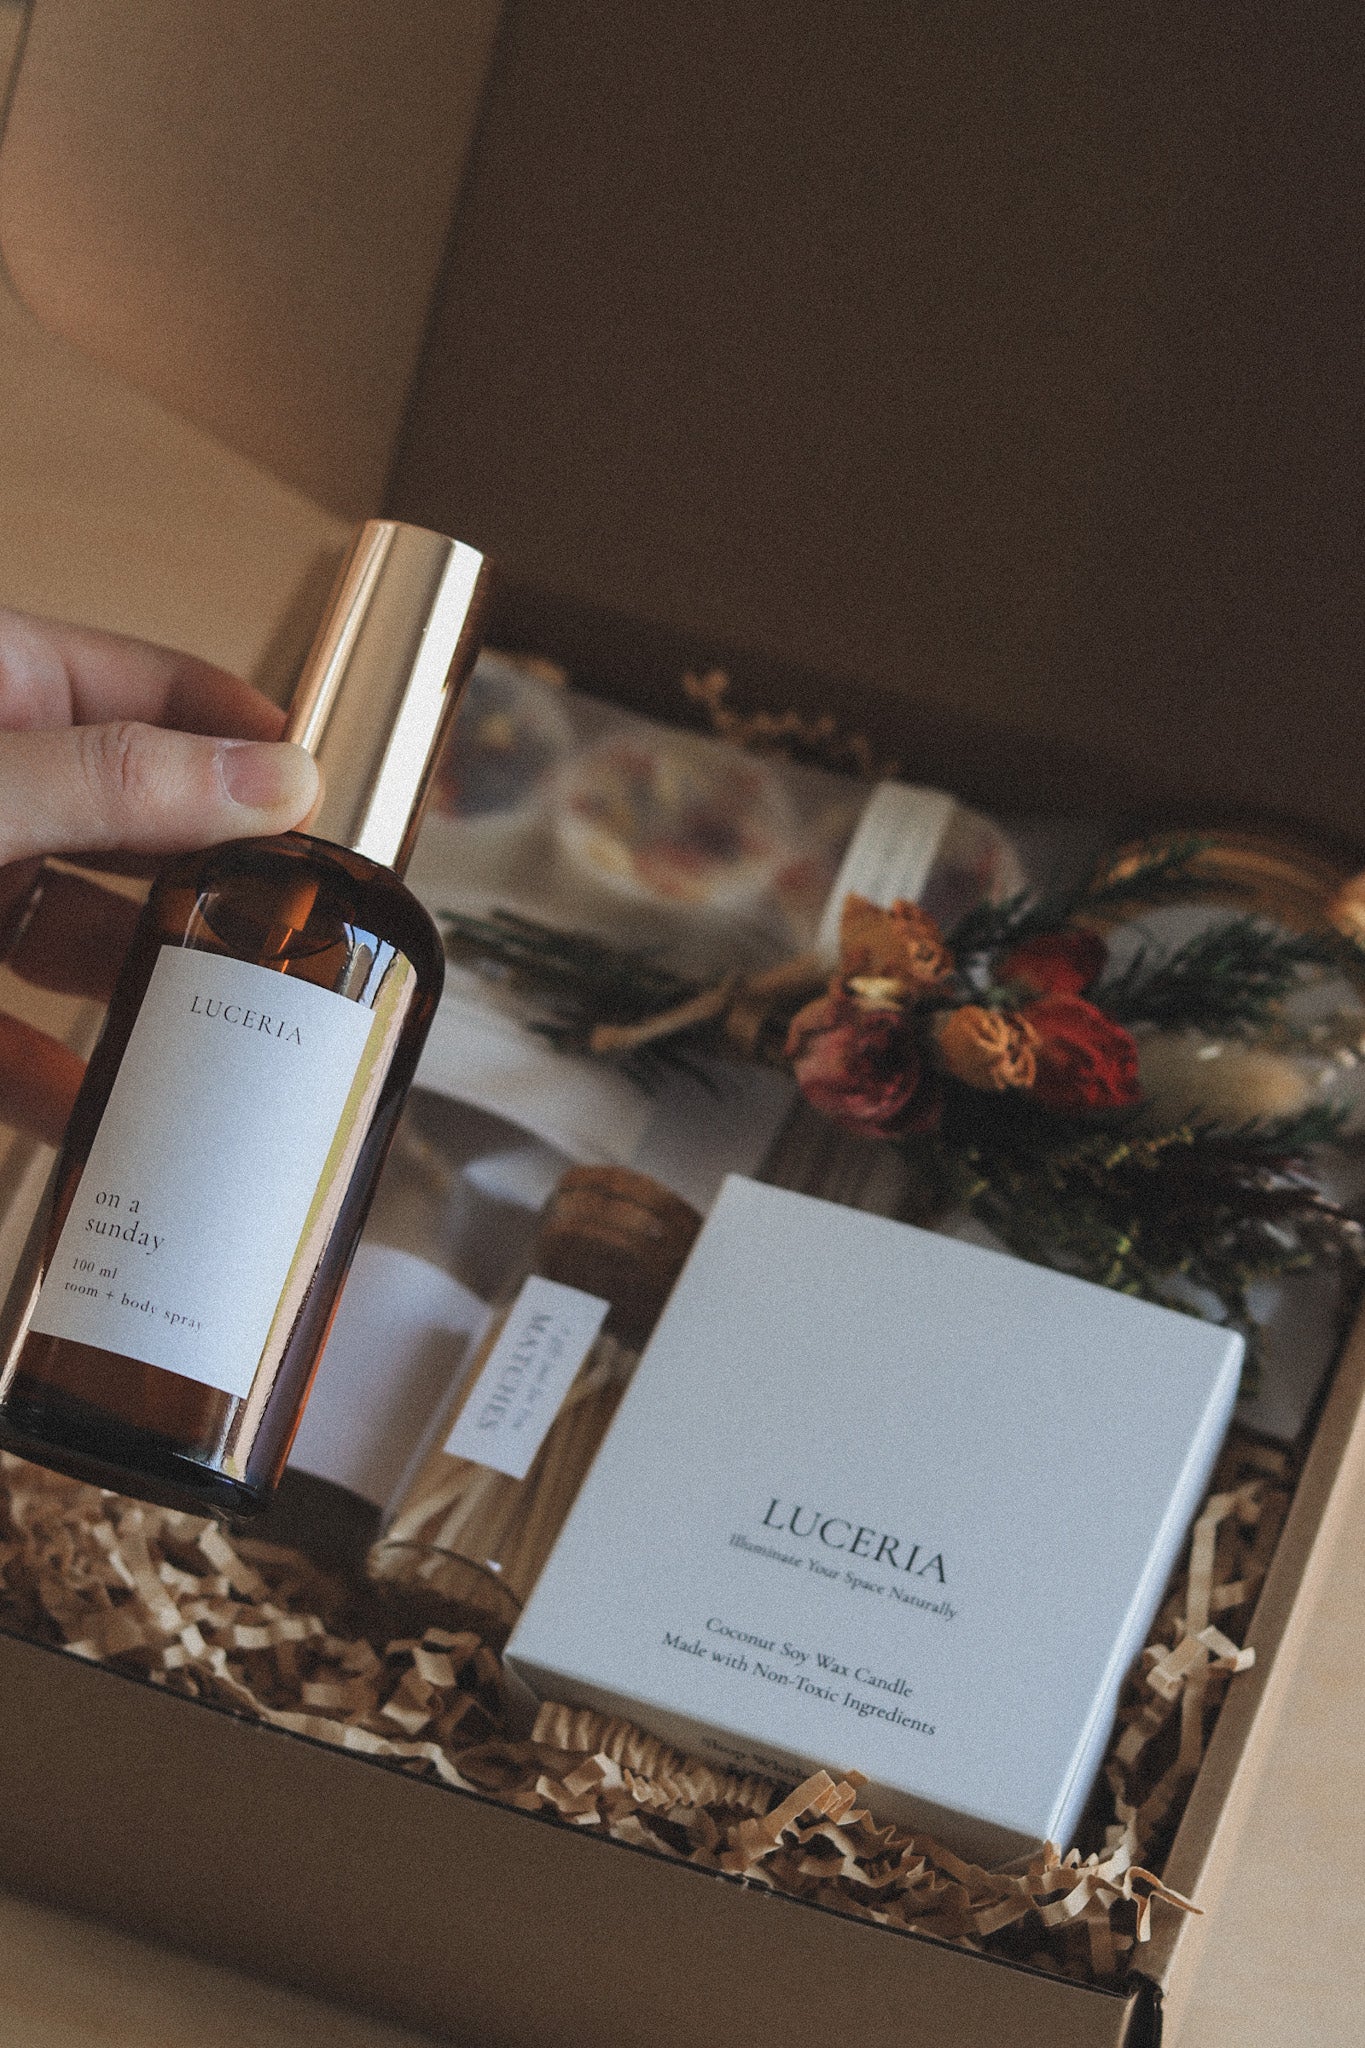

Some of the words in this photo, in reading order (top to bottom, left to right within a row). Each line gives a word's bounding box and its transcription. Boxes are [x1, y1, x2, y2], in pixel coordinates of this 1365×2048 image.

[190, 995, 303, 1046] LUCERIA
[95, 1191, 120, 1208] on
[128, 1199, 140, 1213] a
[72, 1257, 96, 1273] 100
[99, 1267, 118, 1280] ml
[84, 1218, 165, 1256] sunday
[64, 1281, 99, 1298] room
[120, 1292, 155, 1318] body
[164, 1310, 201, 1332] spray
[475, 1313, 553, 1431] MATCHES
[762, 1497, 946, 1584] LUCERIA
[728, 1532, 802, 1568] Illuminate
[808, 1558, 840, 1580] Your
[844, 1570, 885, 1596] Space
[888, 1585, 958, 1623] Naturally
[661, 1631, 708, 1658] Made
[711, 1649, 749, 1673] with
[752, 1661, 840, 1704] Non-Toxic
[842, 1691, 937, 1737] Ingredients
[705, 1616, 776, 1652] Coconut
[780, 1641, 810, 1667] Soy
[815, 1651, 851, 1678] Wax
[854, 1666, 914, 1699] Candle
